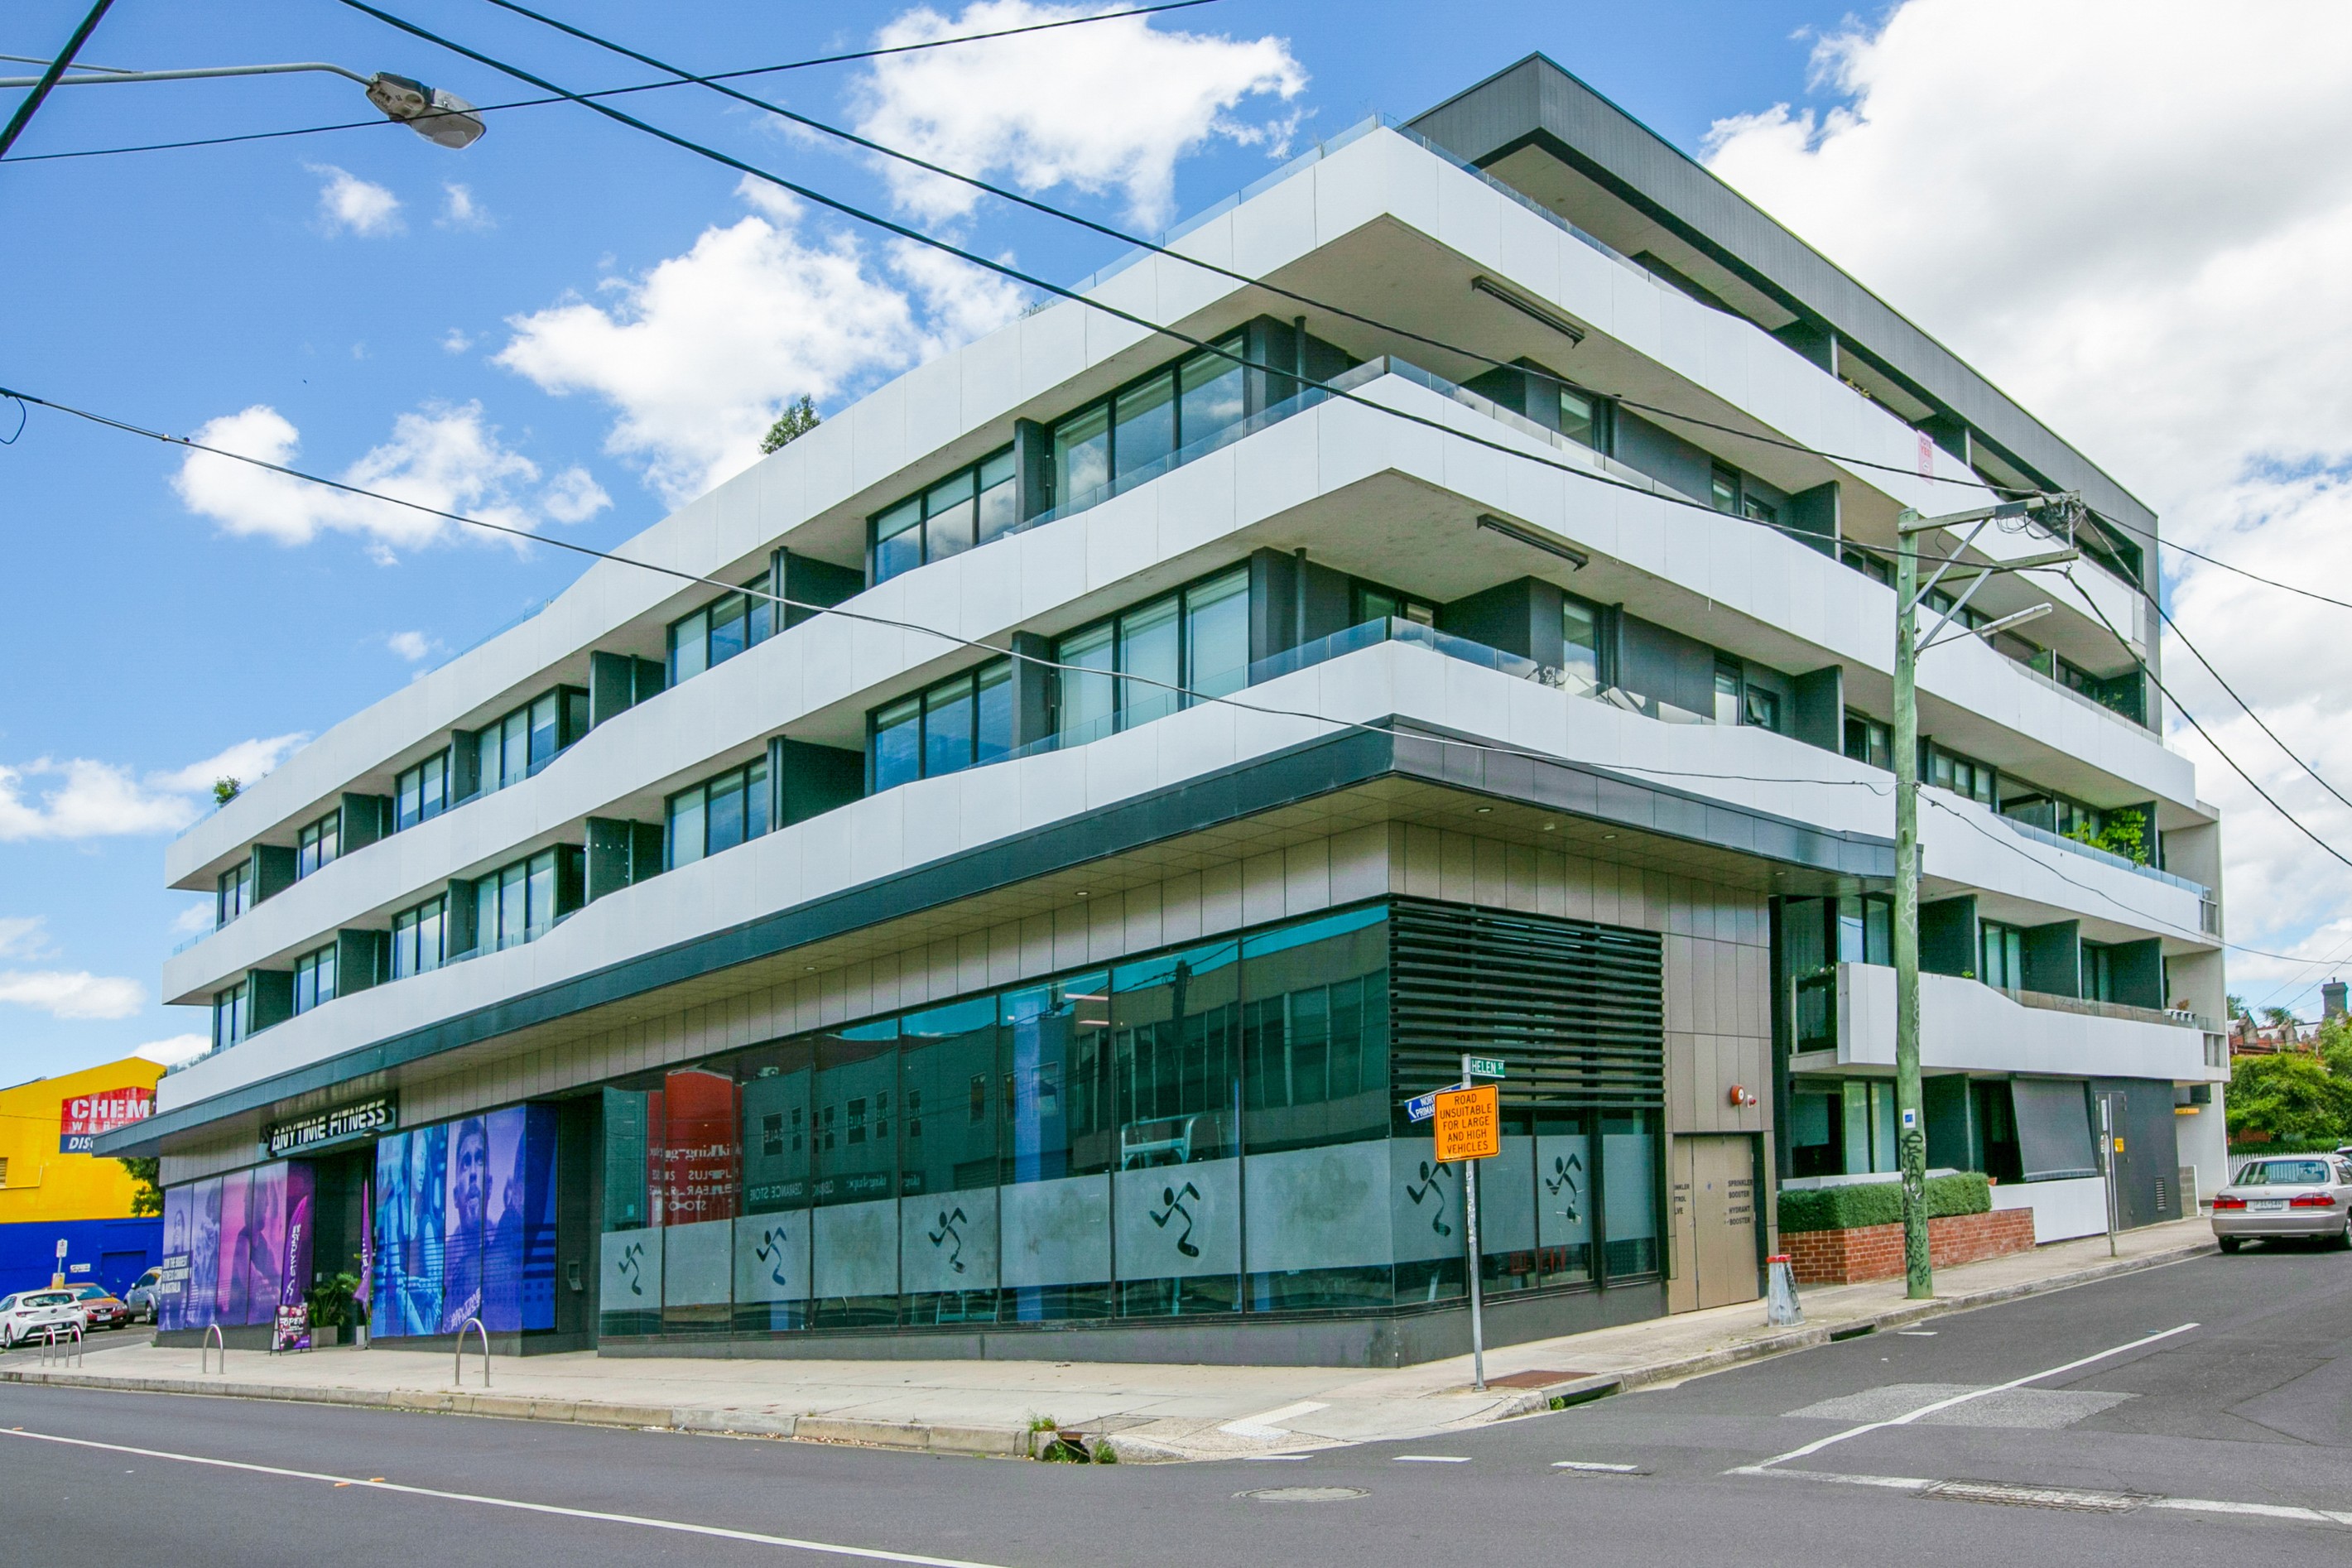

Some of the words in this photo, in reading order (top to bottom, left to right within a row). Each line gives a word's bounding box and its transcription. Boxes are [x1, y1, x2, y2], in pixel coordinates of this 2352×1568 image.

[1471, 1060, 1496, 1075] HELEN
[1498, 1062, 1504, 1070] ST
[1455, 1093, 1477, 1105] ROAD
[1440, 1103, 1492, 1119] UNSUITABLE
[272, 1116, 326, 1152] ANYTIME
[329, 1099, 386, 1137] FITNESS
[1443, 1120, 1459, 1131] FOR
[1462, 1115, 1489, 1128] LARGE
[1447, 1131, 1465, 1142] AND
[1466, 1128, 1487, 1140] HIGH
[1446, 1140, 1489, 1154] VEHICLES
[1728, 1179, 1753, 1187] SPRINKLER
[1729, 1190, 1749, 1199] BOOSTER
[1729, 1205, 1750, 1214] HYDRANT
[1729, 1217, 1750, 1225] BOOSTER
